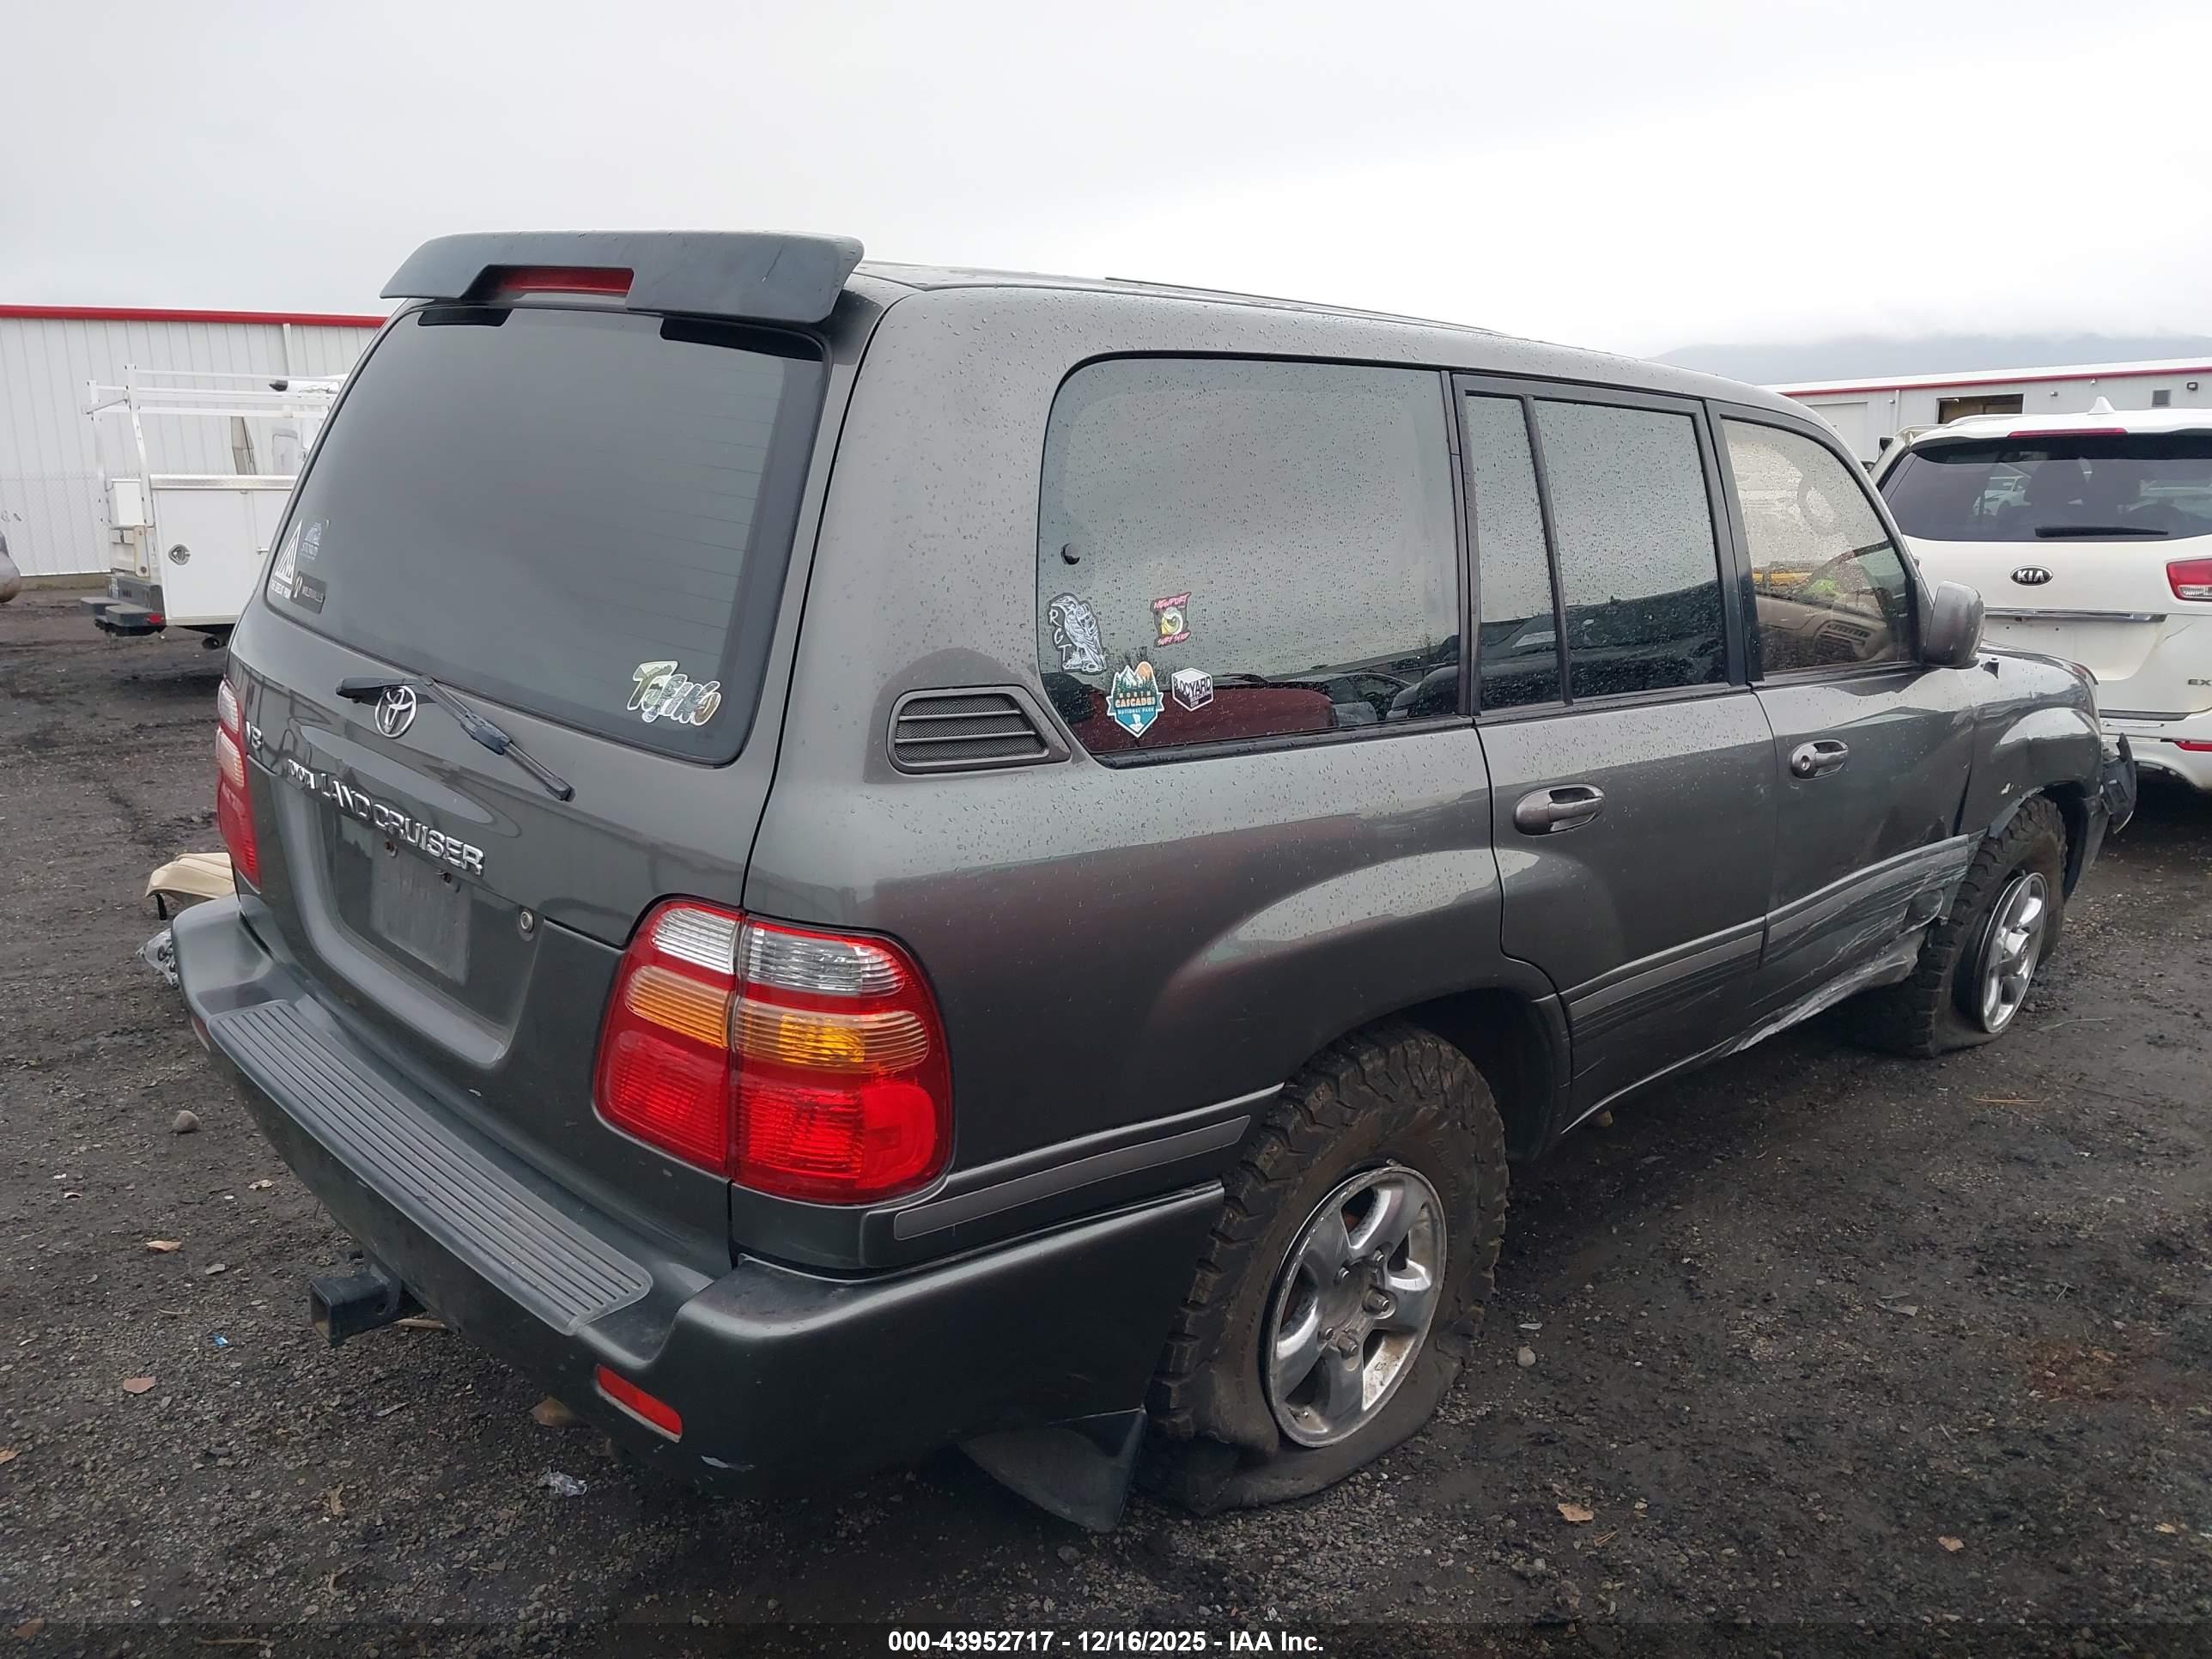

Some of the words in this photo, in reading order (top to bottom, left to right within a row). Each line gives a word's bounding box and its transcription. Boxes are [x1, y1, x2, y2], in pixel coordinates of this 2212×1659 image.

[2017, 570, 2045, 581] KIA
[1119, 690, 1152, 698] NORTH
[1115, 697, 1156, 708] CASCADES
[246, 721, 263, 750] V8
[287, 758, 316, 789] TOYOTA
[321, 773, 371, 821] LAND
[372, 803, 486, 877] CRUISER
